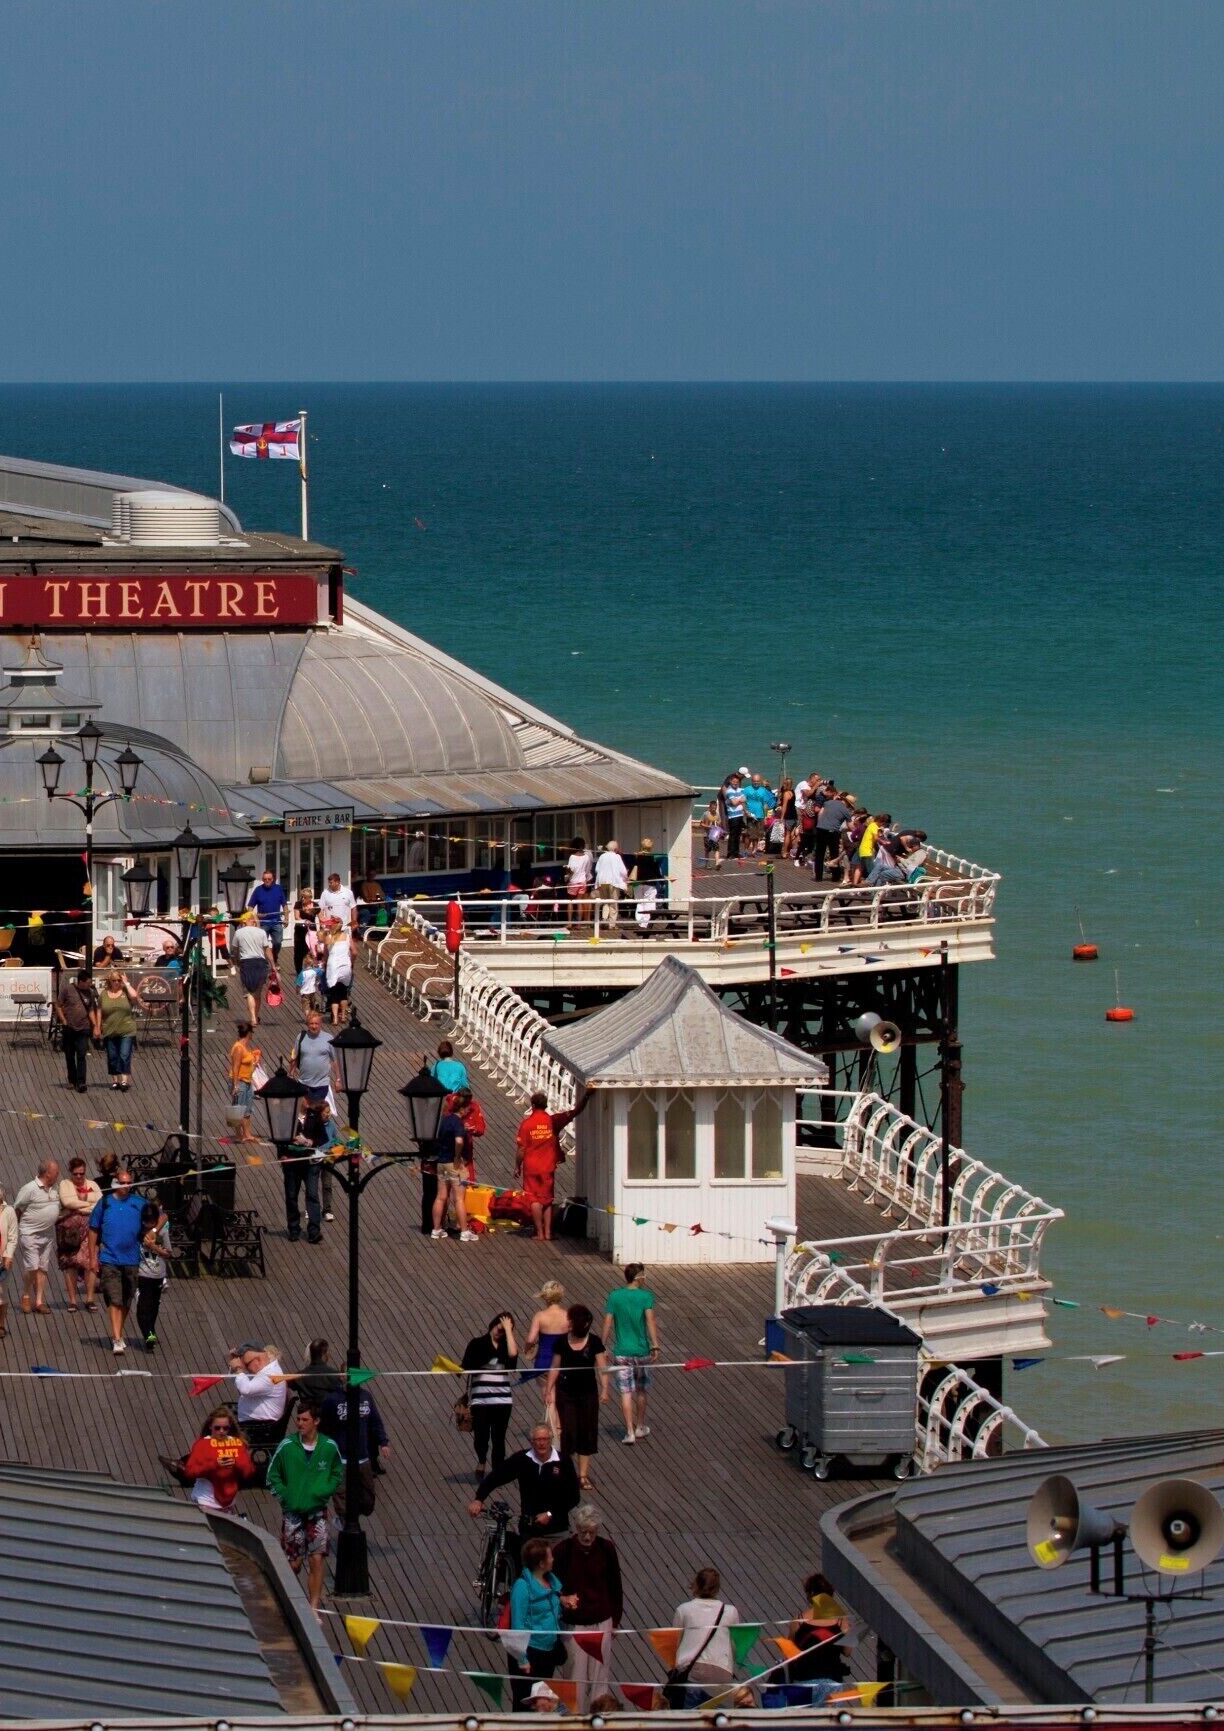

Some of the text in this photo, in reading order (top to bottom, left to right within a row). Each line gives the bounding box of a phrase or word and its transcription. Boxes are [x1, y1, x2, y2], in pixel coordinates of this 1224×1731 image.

[44, 579, 280, 619] THEATRE
[325, 815, 332, 825] &
[334, 813, 351, 824] BAR
[10, 981, 41, 993] deck
